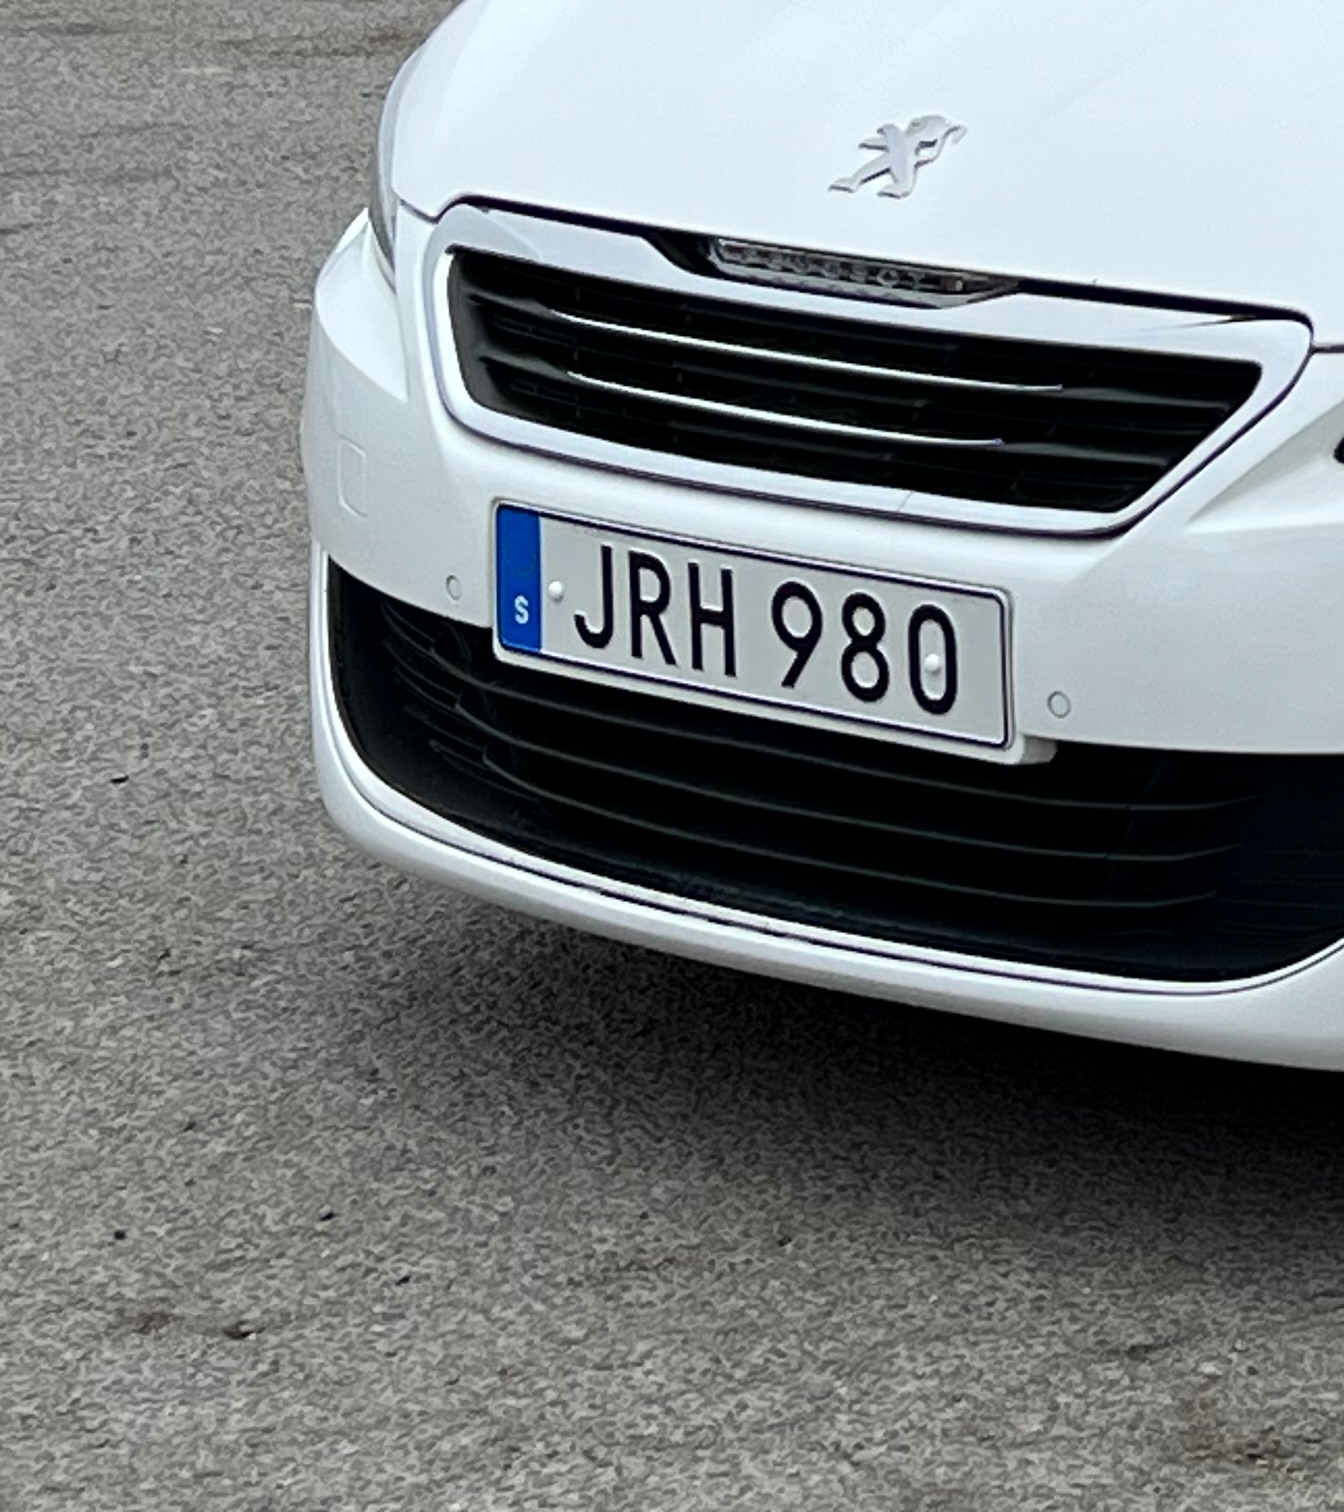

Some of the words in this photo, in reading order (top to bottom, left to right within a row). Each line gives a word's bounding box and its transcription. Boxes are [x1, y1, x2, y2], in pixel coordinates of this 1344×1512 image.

[514, 595, 529, 625] S
[574, 545, 737, 678] JRH
[770, 580, 959, 716] 980
